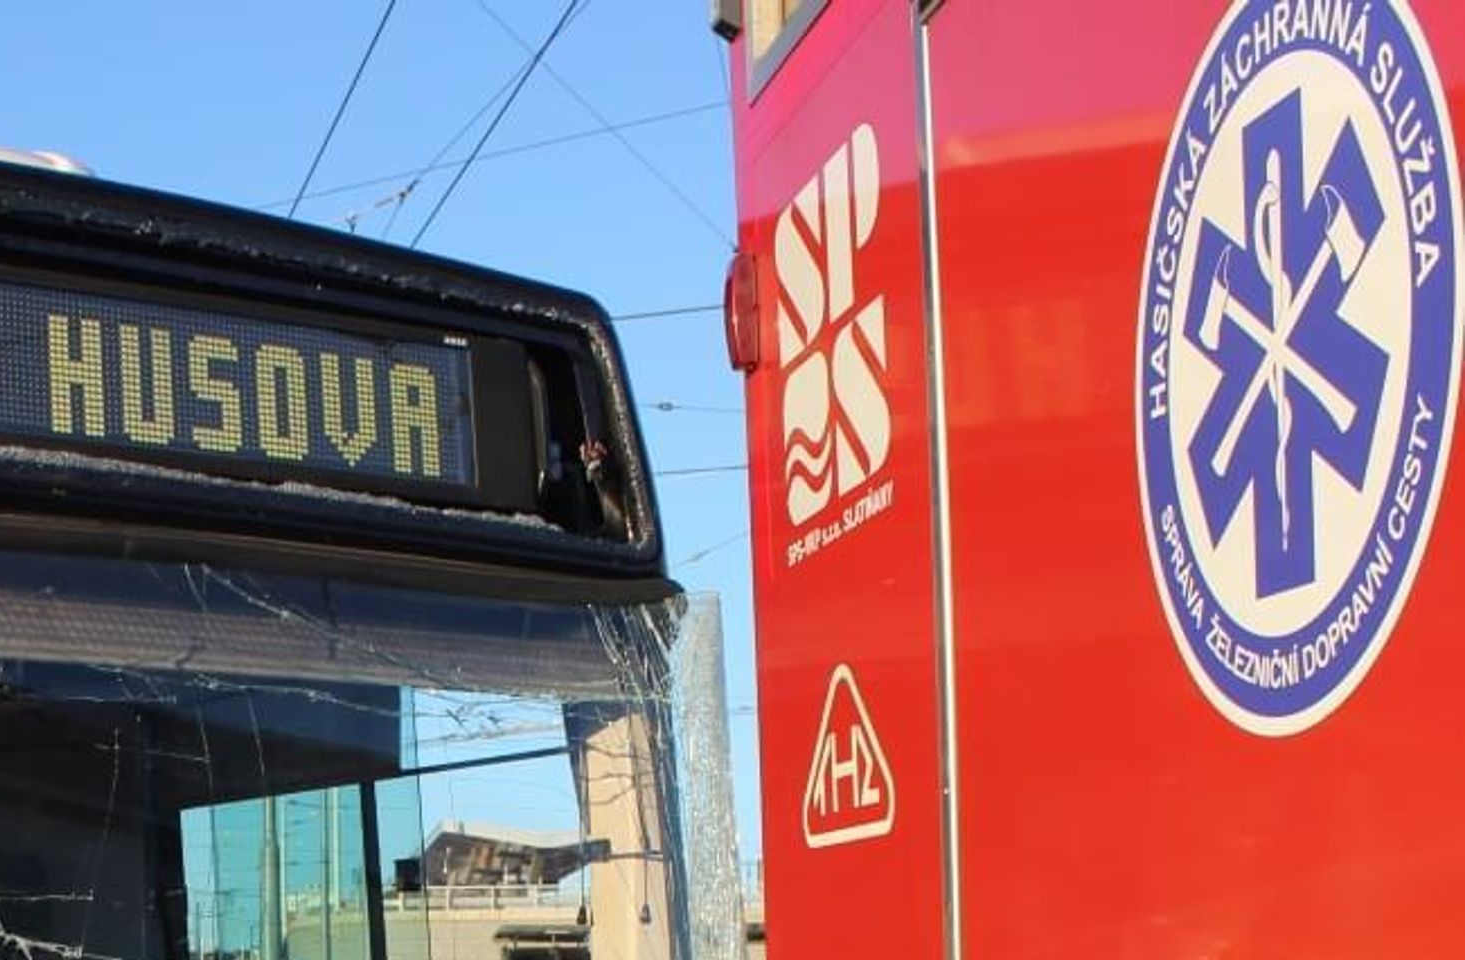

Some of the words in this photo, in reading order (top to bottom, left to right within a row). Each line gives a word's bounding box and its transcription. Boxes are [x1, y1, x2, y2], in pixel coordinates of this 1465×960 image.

[1151, 126, 1207, 418] HASIČSKÁ
[1203, 0, 1370, 134] ZÁCHRANNÁ
[1370, 42, 1440, 288] SLUŽBA
[47, 314, 441, 478] HUSOVA
[1162, 505, 1207, 630] SPRÁVA
[1205, 614, 1301, 690] ŽELEZNIČNÍ
[1303, 532, 1394, 678] DOPRAVNÍ
[1387, 393, 1433, 541] CESTY
